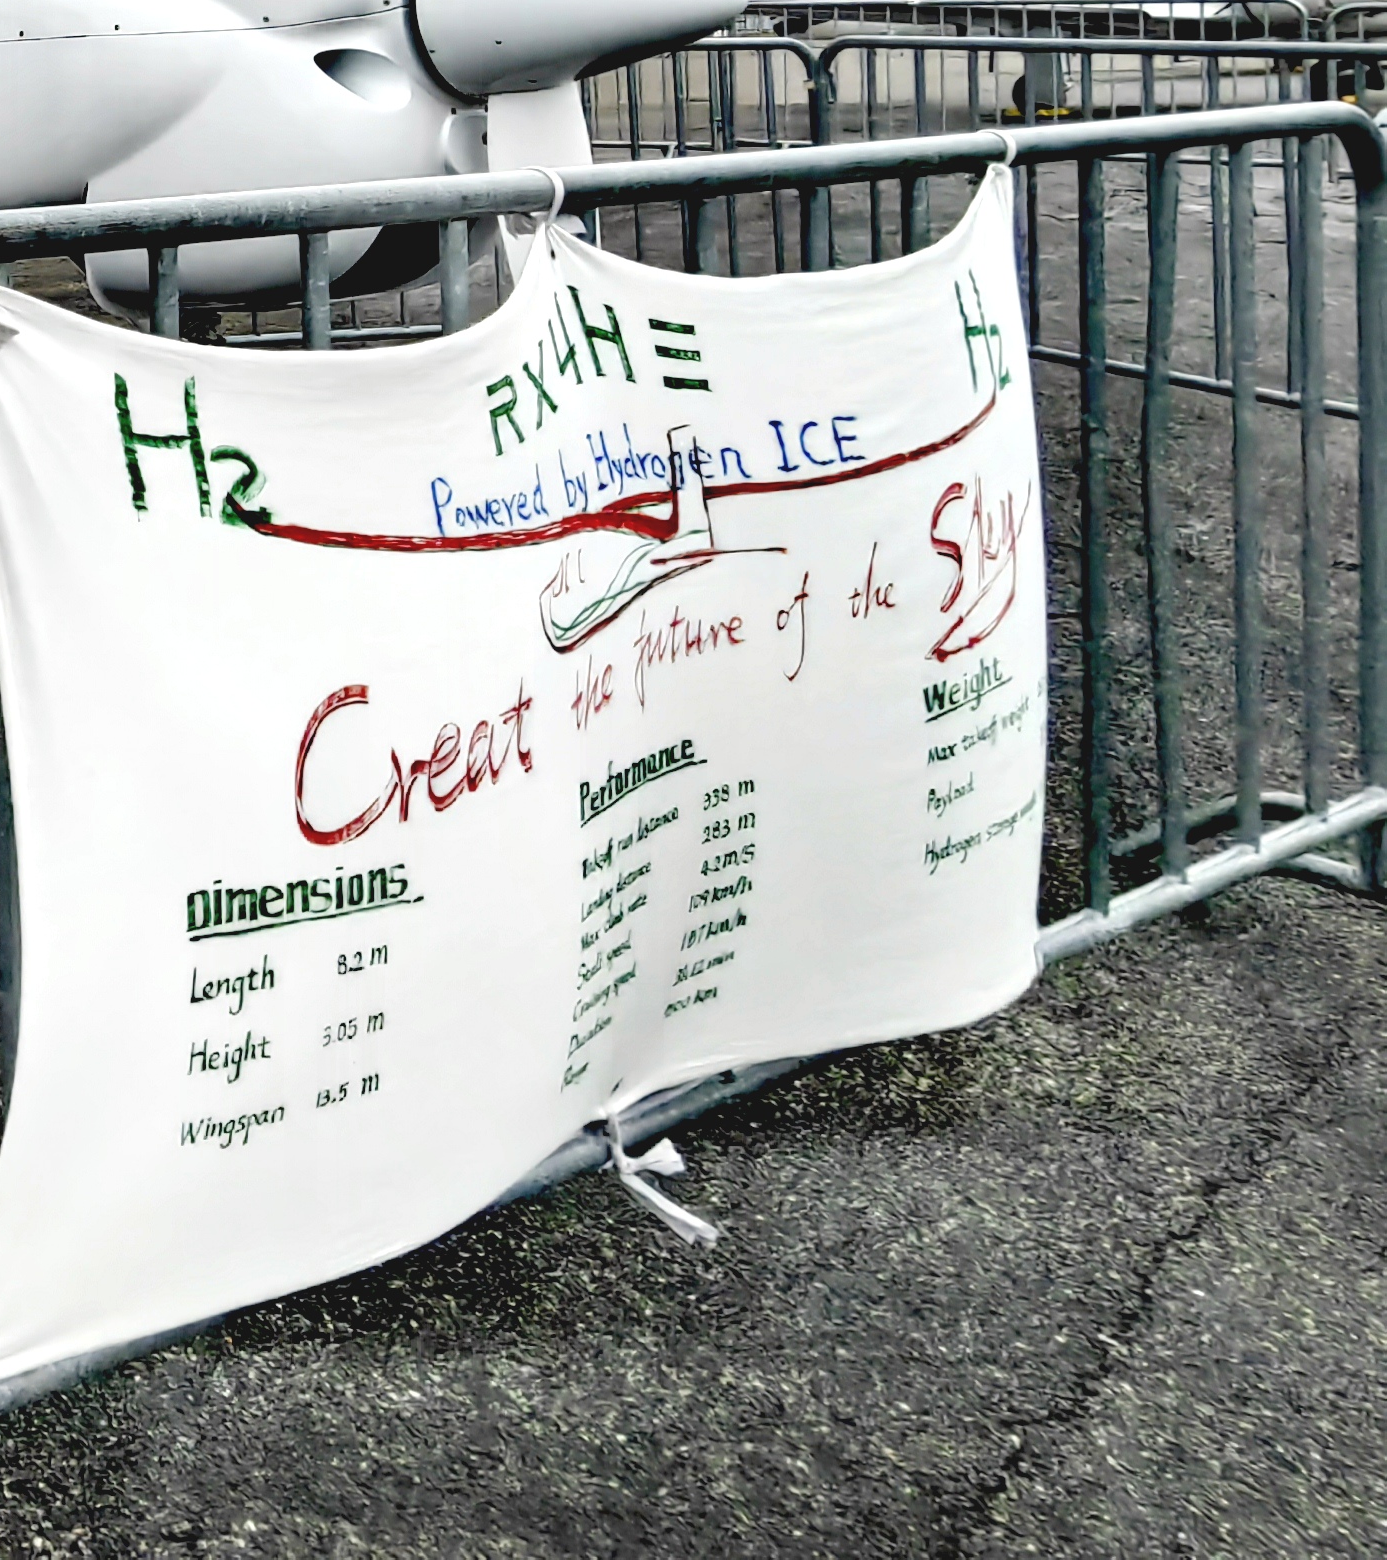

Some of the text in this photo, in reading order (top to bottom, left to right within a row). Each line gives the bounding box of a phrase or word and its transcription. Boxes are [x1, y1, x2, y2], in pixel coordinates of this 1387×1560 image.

[954, 268, 1012, 393] H2
[114, 372, 273, 526] H2
[431, 416, 867, 537] Powered by Hydrogen ICE
[295, 473, 1031, 846] Creat the future of the Sky
[923, 657, 1004, 711] Weight
[580, 739, 695, 821] Performance
[703, 784, 730, 811] 338
[738, 779, 756, 797] m
[701, 819, 731, 844] 283
[737, 812, 756, 831] m
[186, 864, 409, 932] Dimensions
[190, 945, 388, 1016] Length 8.2 m
[187, 1012, 385, 1084] Height 3.05 m
[180, 1106, 285, 1149] Wingspan
[361, 1073, 380, 1095] m
